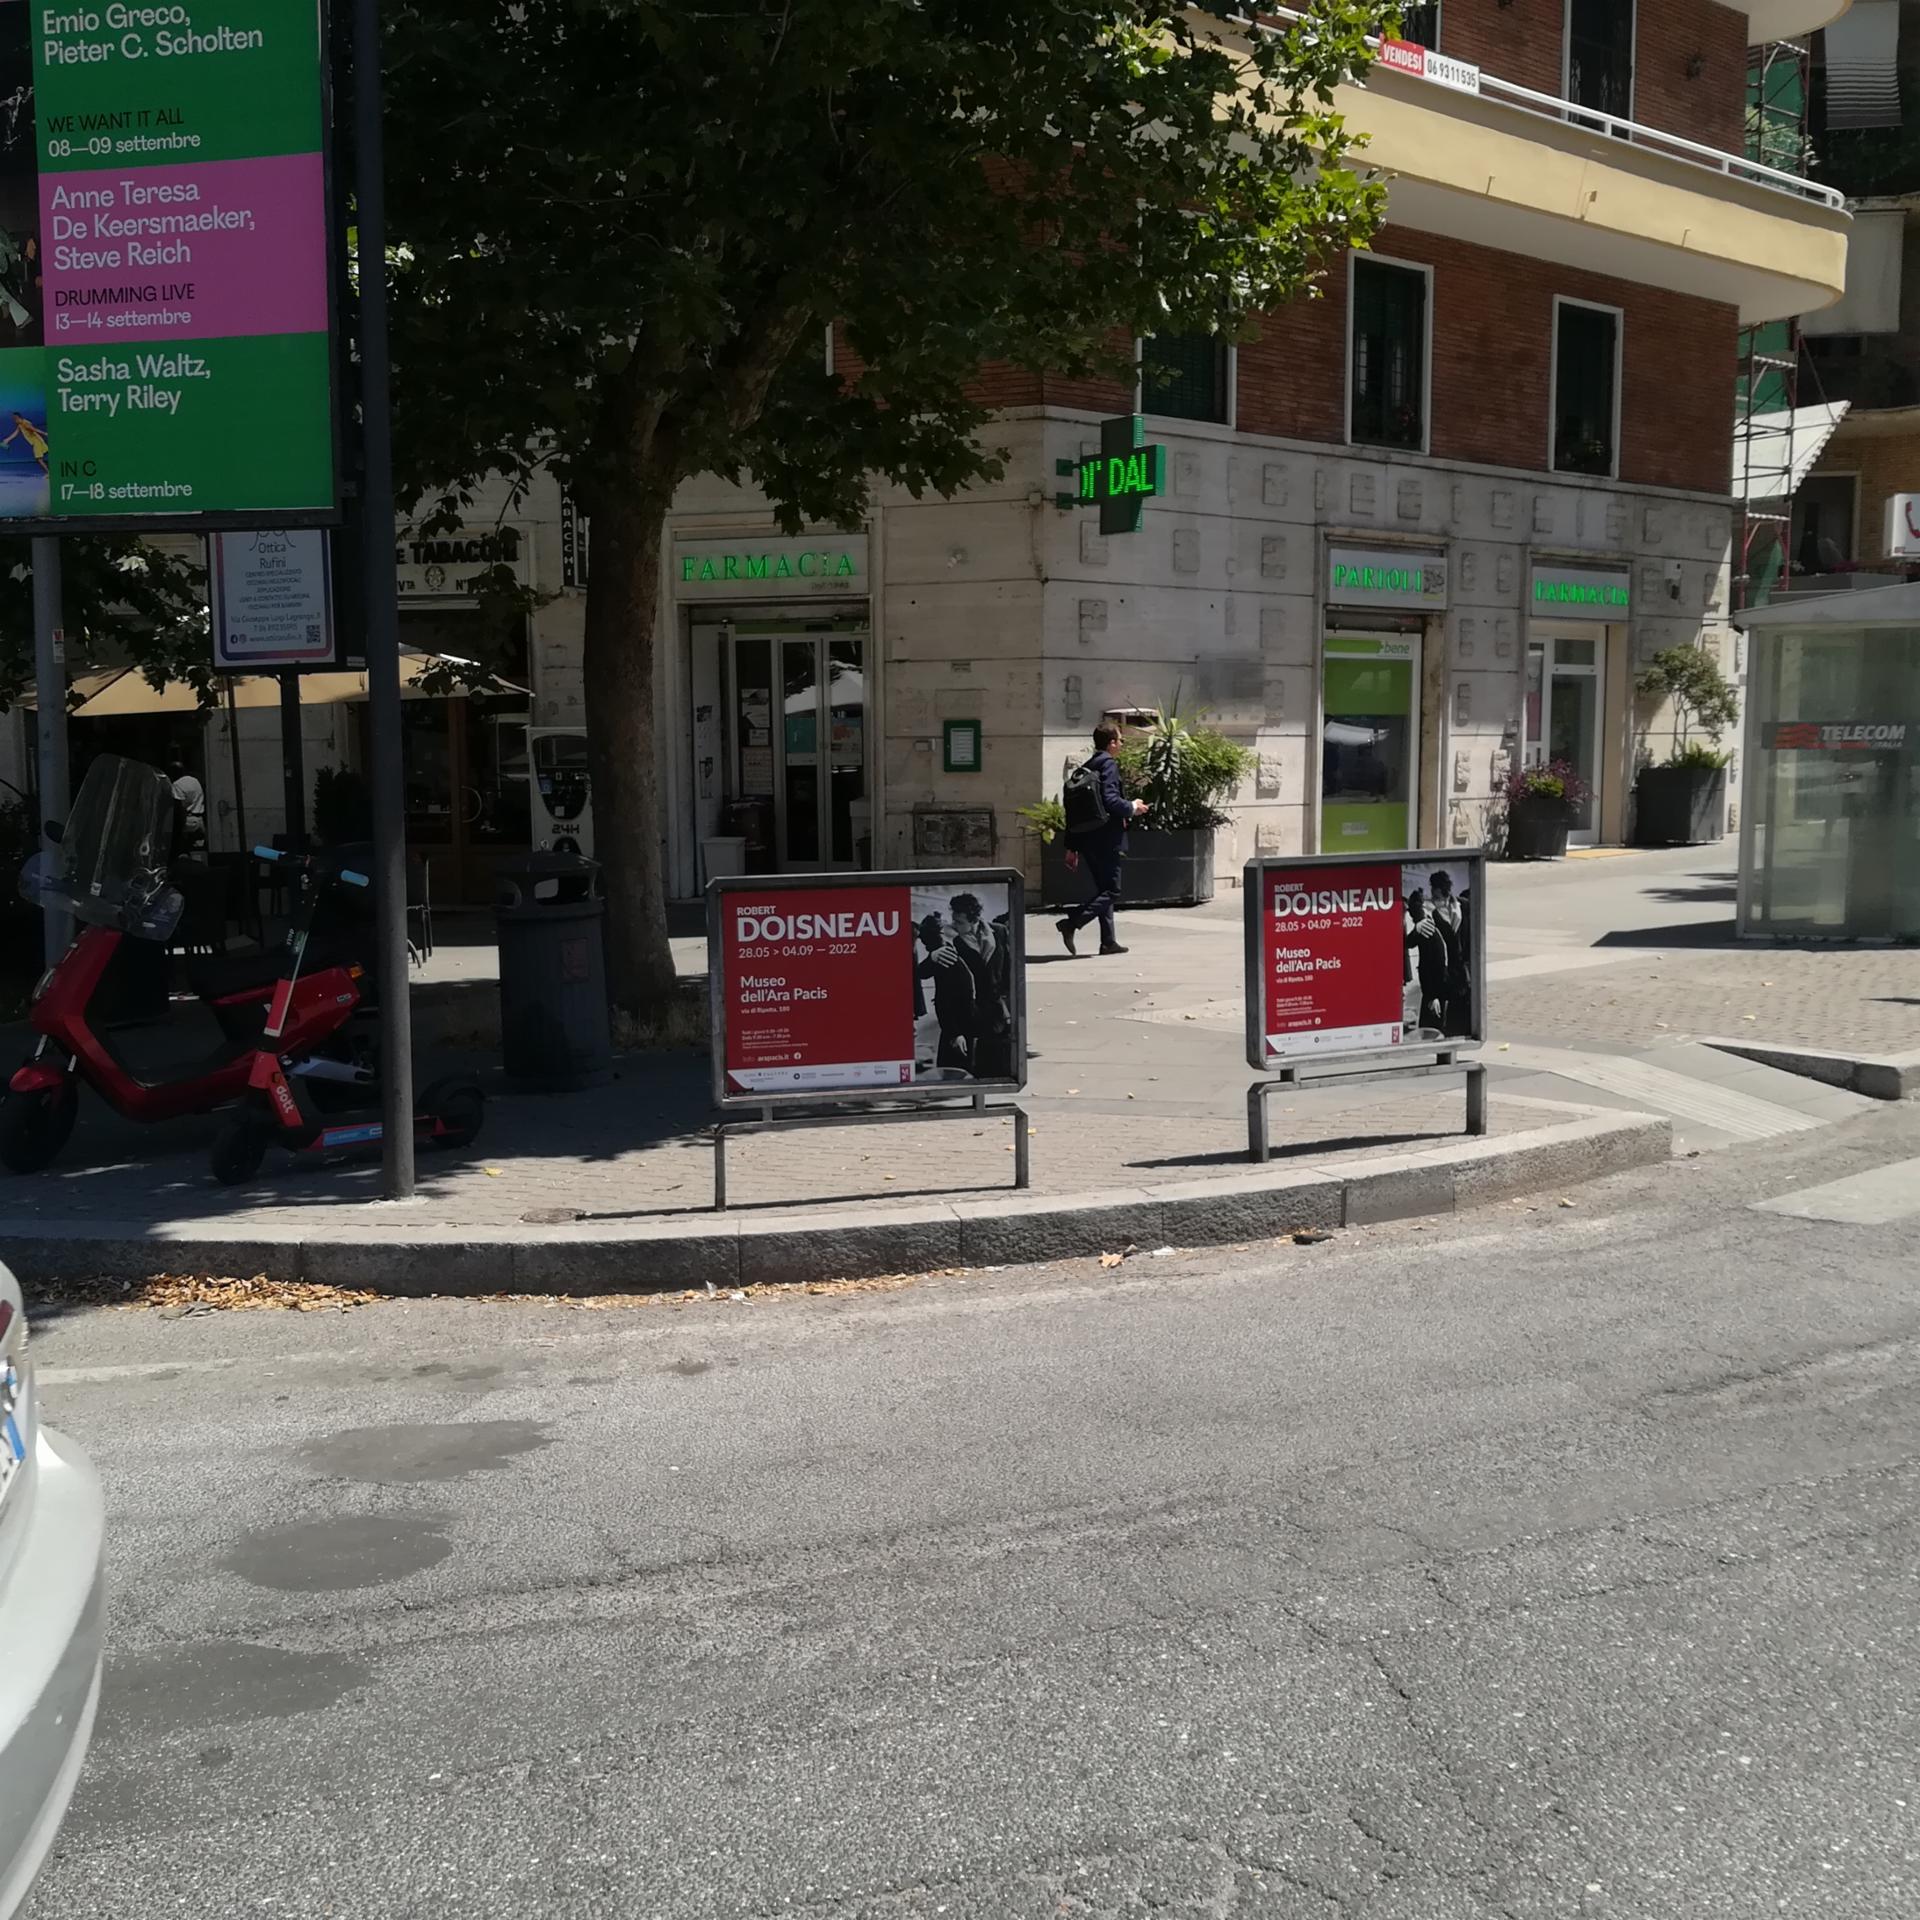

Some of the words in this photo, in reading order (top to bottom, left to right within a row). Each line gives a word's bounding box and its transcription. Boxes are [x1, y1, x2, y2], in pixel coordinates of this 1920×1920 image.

[43, 8, 99, 35] Emio
[105, 3, 191, 29] Greco,
[44, 40, 115, 65] Pieter
[121, 33, 149, 59] C.
[156, 26, 263, 57] Scholten
[1383, 43, 1422, 71] VENDESI
[1427, 58, 1437, 76] 06
[47, 115, 74, 133] WE
[78, 111, 132, 131] WANT
[137, 110, 151, 127] IT
[156, 107, 184, 126] ALL
[116, 132, 201, 153] settembre
[51, 186, 114, 210] Anne
[120, 181, 200, 206] Teresa
[53, 215, 87, 240] De
[94, 205, 255, 239] Keersmaeker,
[54, 246, 121, 270] Steve
[128, 239, 191, 266] Reich
[55, 285, 157, 306] DRUMMING
[162, 283, 195, 301] LIVE
[106, 308, 191, 328] settembre
[57, 357, 131, 383] Sasha
[136, 353, 211, 379] Waltz,
[57, 388, 120, 417] Terry
[127, 384, 181, 415] Riley
[61, 461, 77, 477] IN
[83, 460, 97, 477] C
[1109, 453, 1153, 495] DAL
[108, 481, 192, 499] settembre
[562, 484, 574, 576] TABACCHI
[258, 541, 287, 554] Ottica
[259, 557, 287, 569] Rufini
[681, 552, 857, 582] FARMACIA
[1334, 564, 1422, 593] PARIOLI
[1535, 580, 1629, 607] FARMACIA
[1822, 725, 1906, 740] TELECOM
[552, 824, 580, 834] 24H
[1274, 883, 1304, 893] ROBERT
[736, 905, 776, 916] ROBERT
[1274, 887, 1394, 917] DOISNEAU
[737, 911, 899, 942] DOISNEAU
[1275, 921, 1299, 932] 28.05
[1307, 919, 1331, 930] 04.09
[1342, 917, 1363, 927] 2022
[738, 947, 770, 959] 28.05
[782, 945, 813, 957] 04.09
[829, 943, 857, 955] 2022
[1276, 948, 1310, 959] Museo
[1315, 957, 1341, 970] Pacis
[740, 975, 786, 988] Museo
[793, 987, 827, 1000] Pacis
[276, 1086, 296, 1113] dott
